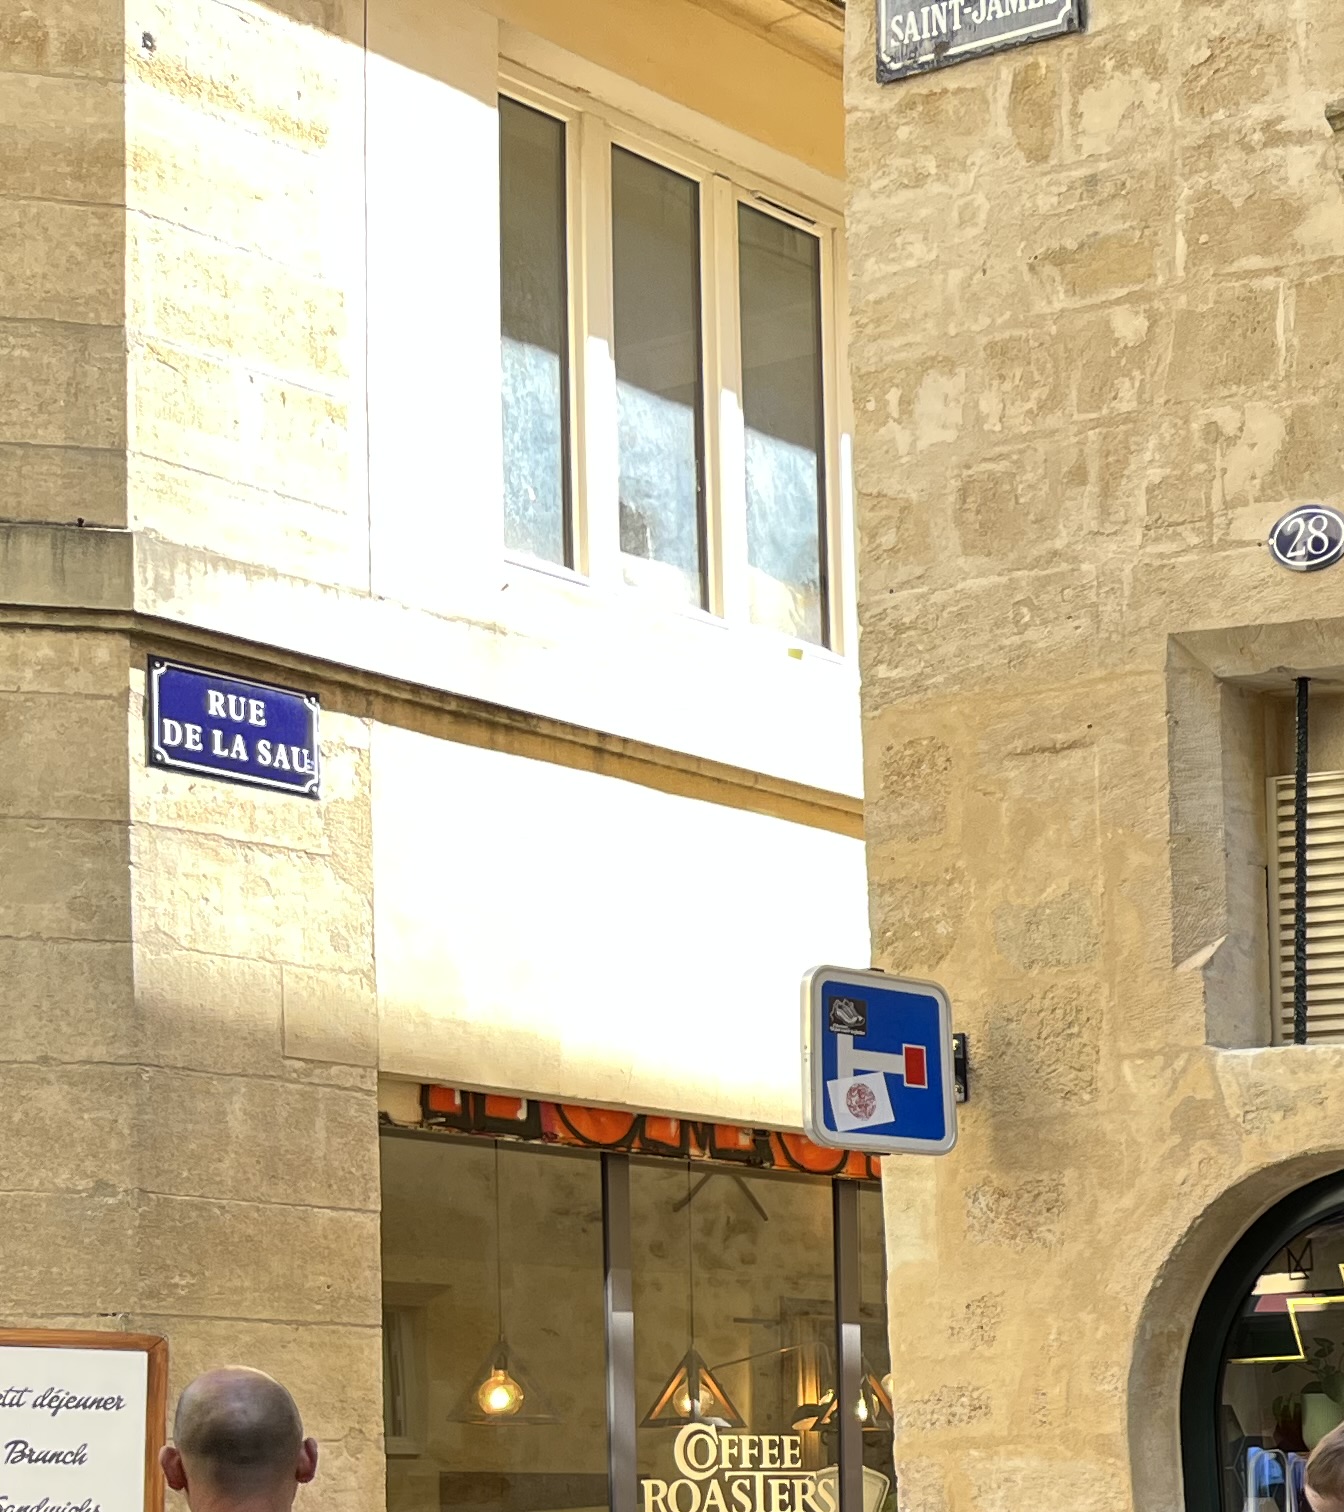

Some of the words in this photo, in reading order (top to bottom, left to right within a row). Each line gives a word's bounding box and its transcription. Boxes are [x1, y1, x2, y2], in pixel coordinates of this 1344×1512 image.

[890, 0, 1057, 47] SAINT-JA
[1286, 515, 1329, 558] 28
[207, 690, 267, 727] RUE
[163, 718, 203, 751] DE
[212, 730, 249, 761] LA
[0, 1386, 33, 1407] tit
[32, 1387, 125, 1416] déjeuner
[4, 1439, 88, 1466] Brunch
[674, 1423, 801, 1480] COFFEE
